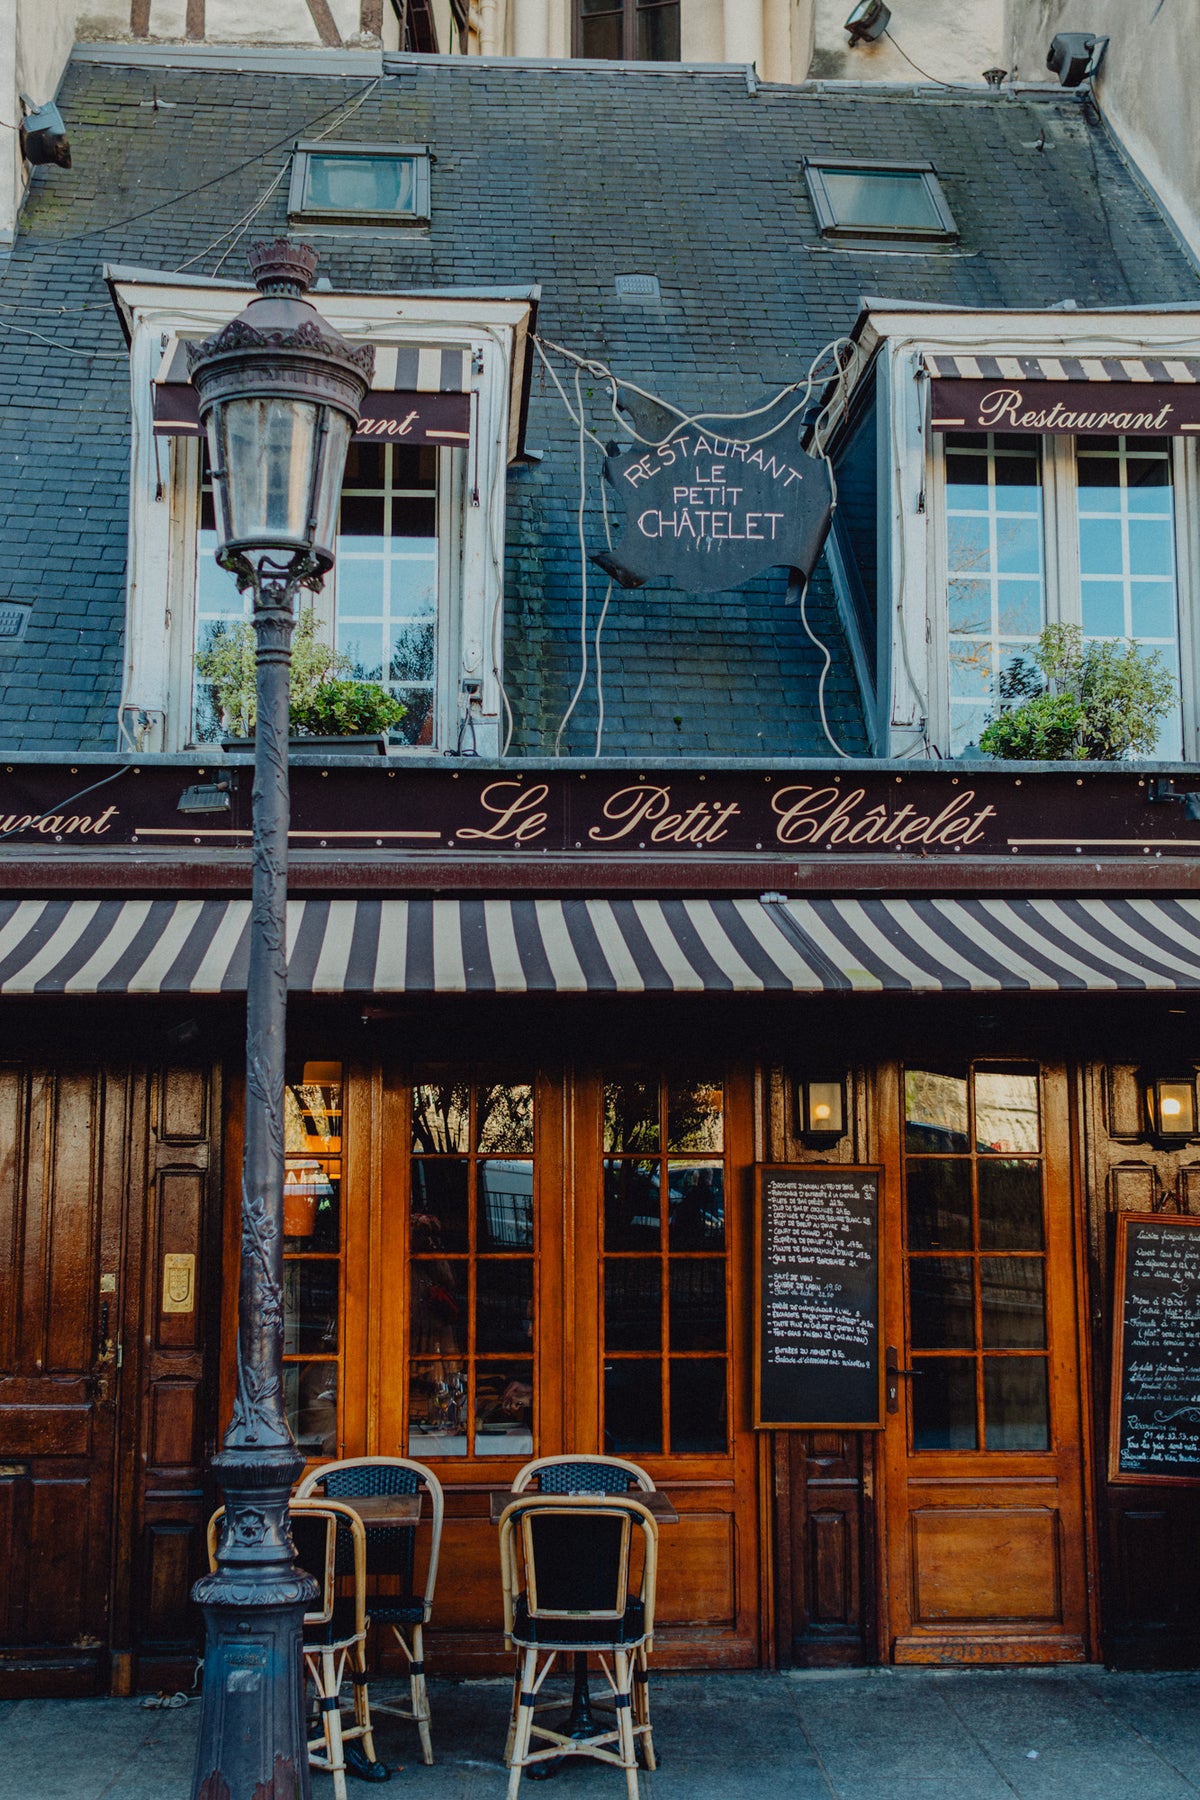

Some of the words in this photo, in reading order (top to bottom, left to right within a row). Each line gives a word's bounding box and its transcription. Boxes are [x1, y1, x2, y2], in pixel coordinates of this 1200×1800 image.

[978, 389, 1174, 430] Restaurant
[623, 436, 803, 488] RESTAURANT
[696, 465, 726, 483] LE
[673, 486, 743, 506] PETIT
[637, 508, 784, 540] CHÂTELET
[456, 782, 549, 841] Le
[589, 785, 741, 842] Petit
[772, 786, 997, 844] Châtelet
